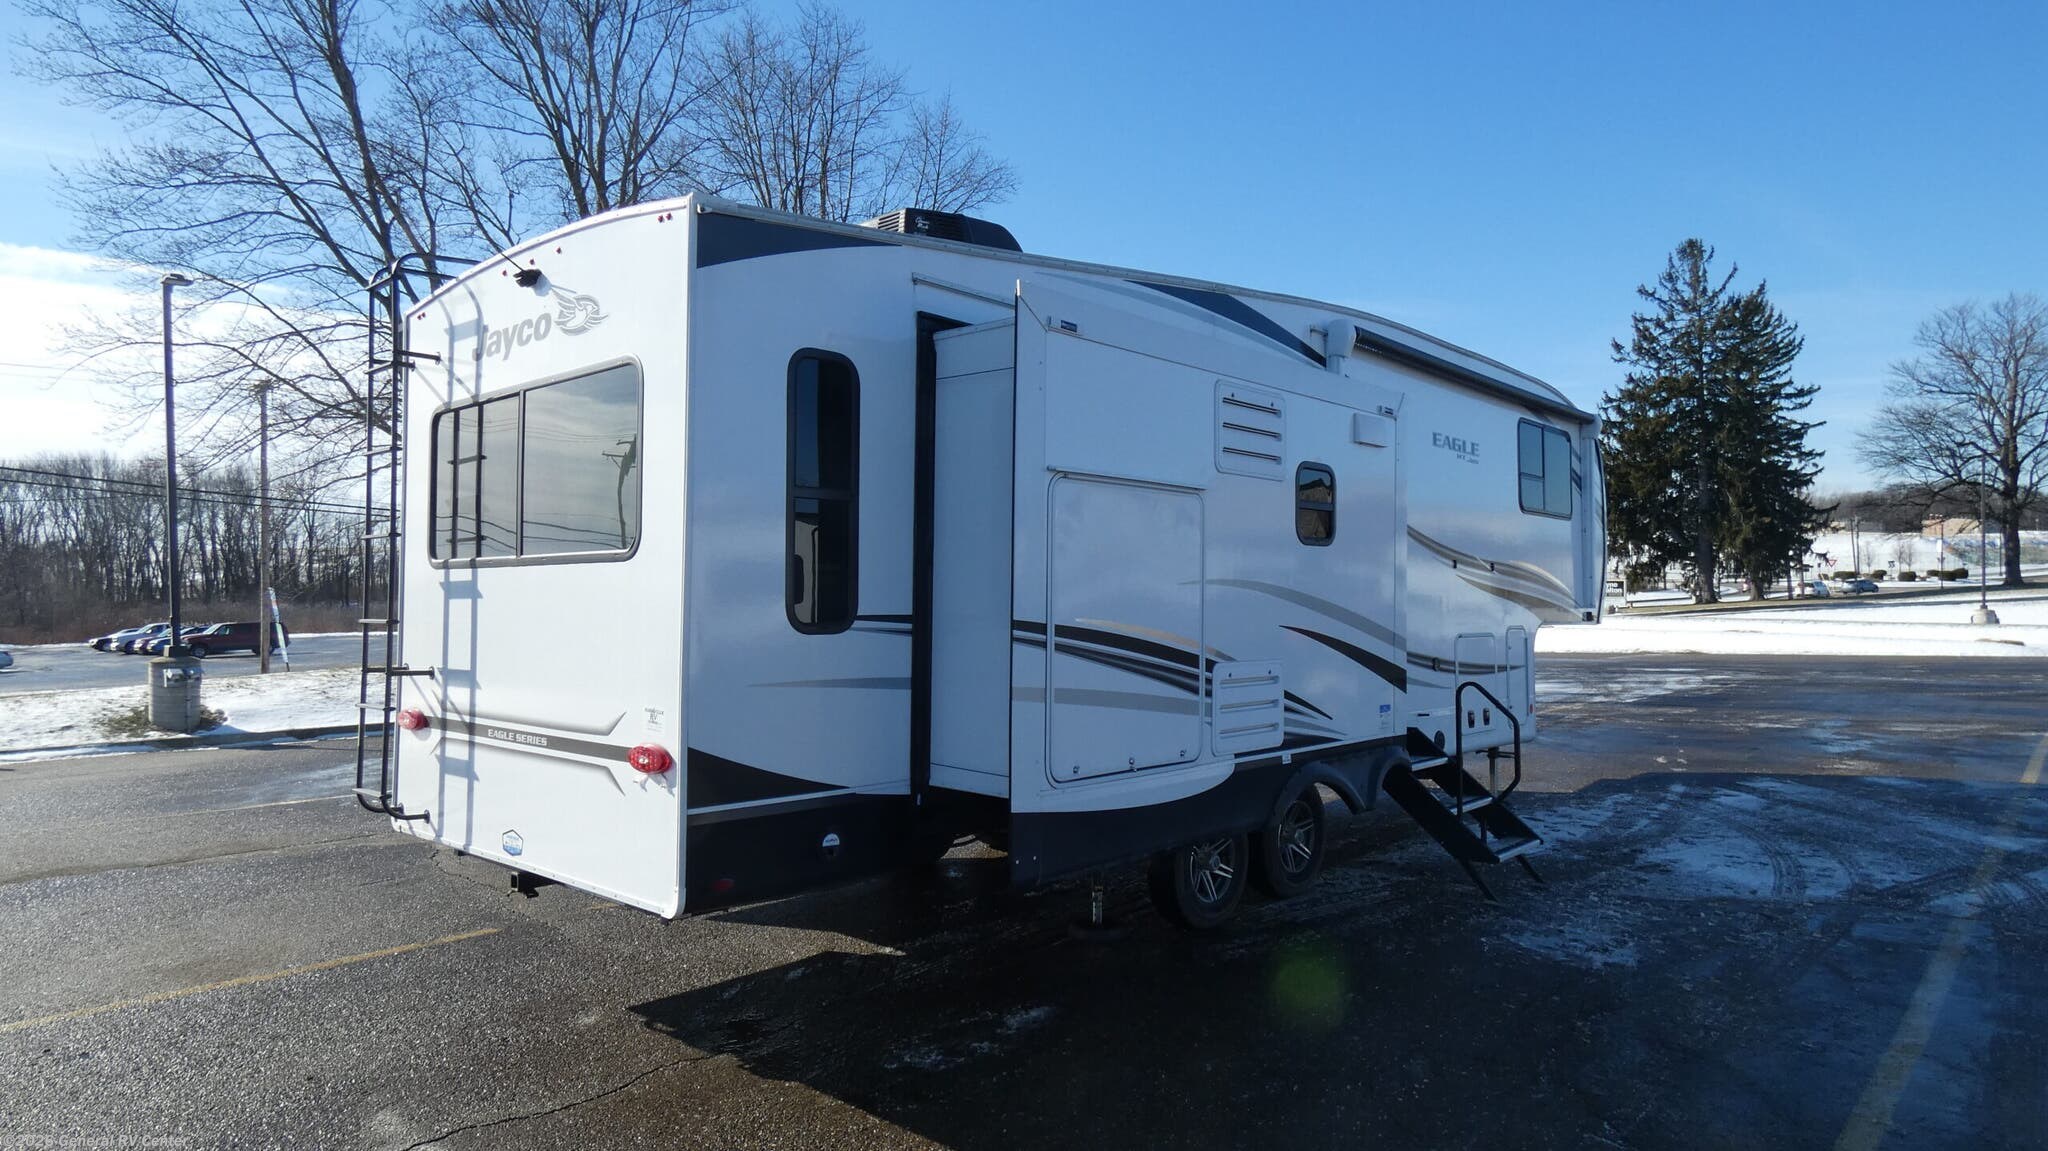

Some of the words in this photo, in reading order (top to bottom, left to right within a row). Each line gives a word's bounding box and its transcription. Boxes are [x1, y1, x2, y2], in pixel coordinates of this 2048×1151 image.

[472, 312, 552, 361] Jayco
[1432, 431, 1480, 457] EAGLE
[488, 728, 514, 741] EAGLE
[516, 733, 547, 746] SERIES
